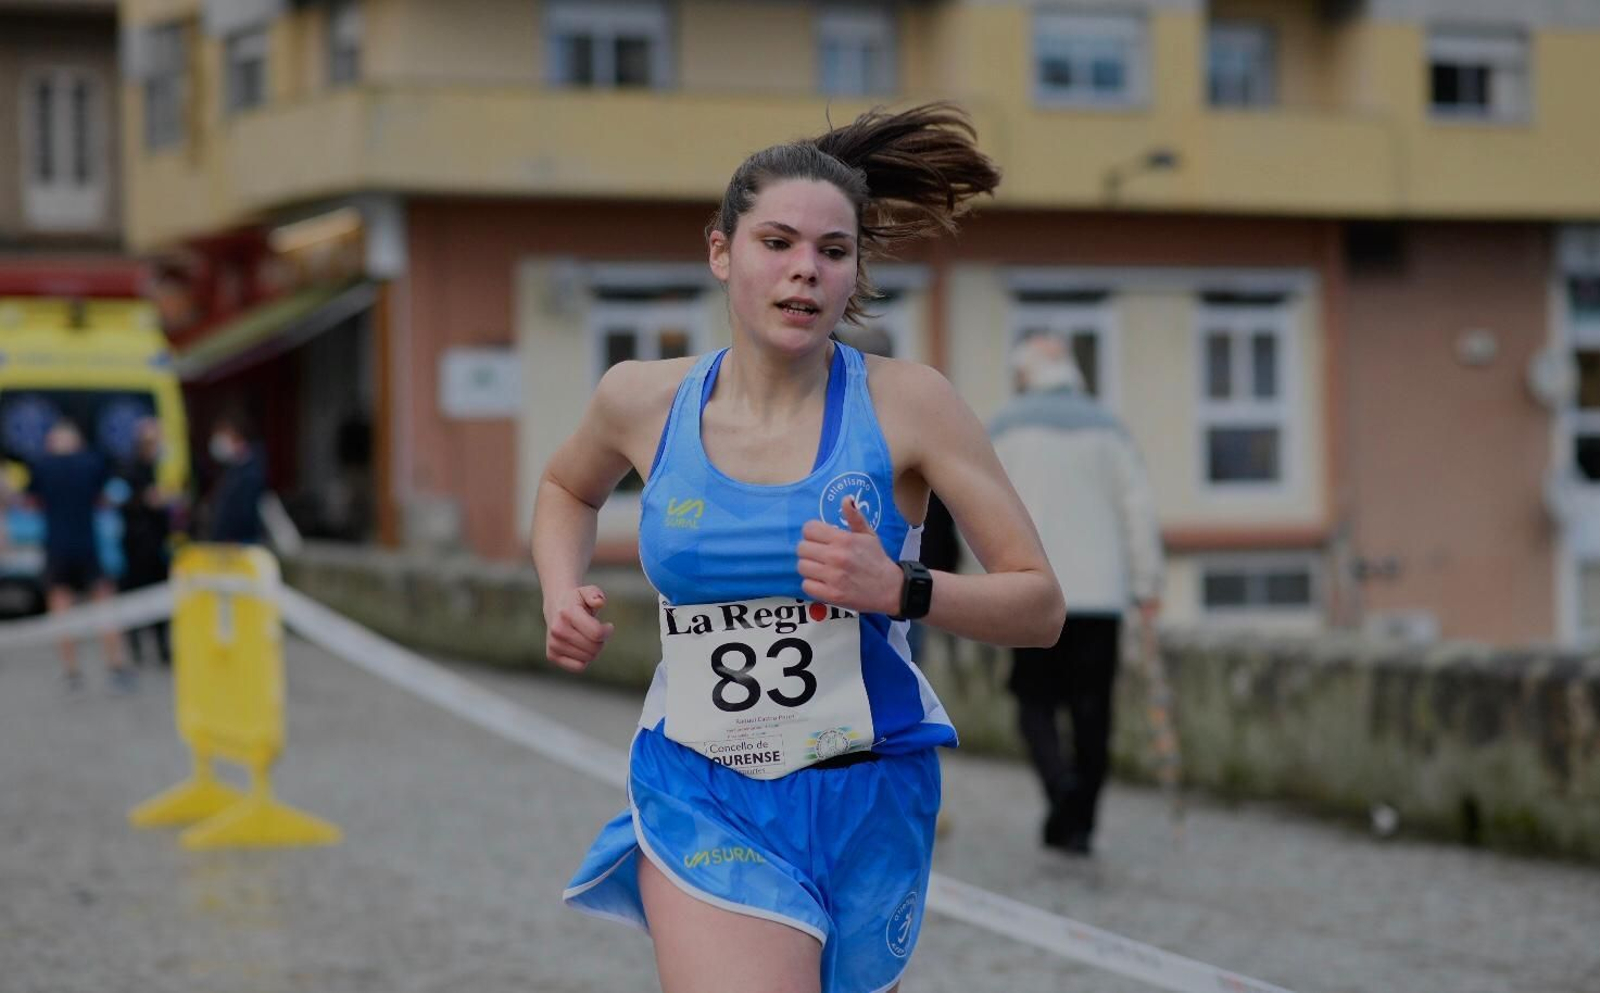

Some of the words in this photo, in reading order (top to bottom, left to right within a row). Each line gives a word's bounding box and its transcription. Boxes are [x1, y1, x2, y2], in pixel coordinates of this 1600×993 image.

[827, 477, 870, 502] atletismo
[663, 607, 715, 636] La
[710, 637, 818, 713] 83
[709, 741, 754, 754] Concello
[756, 740, 769, 750] de
[711, 846, 764, 866] SURAL
